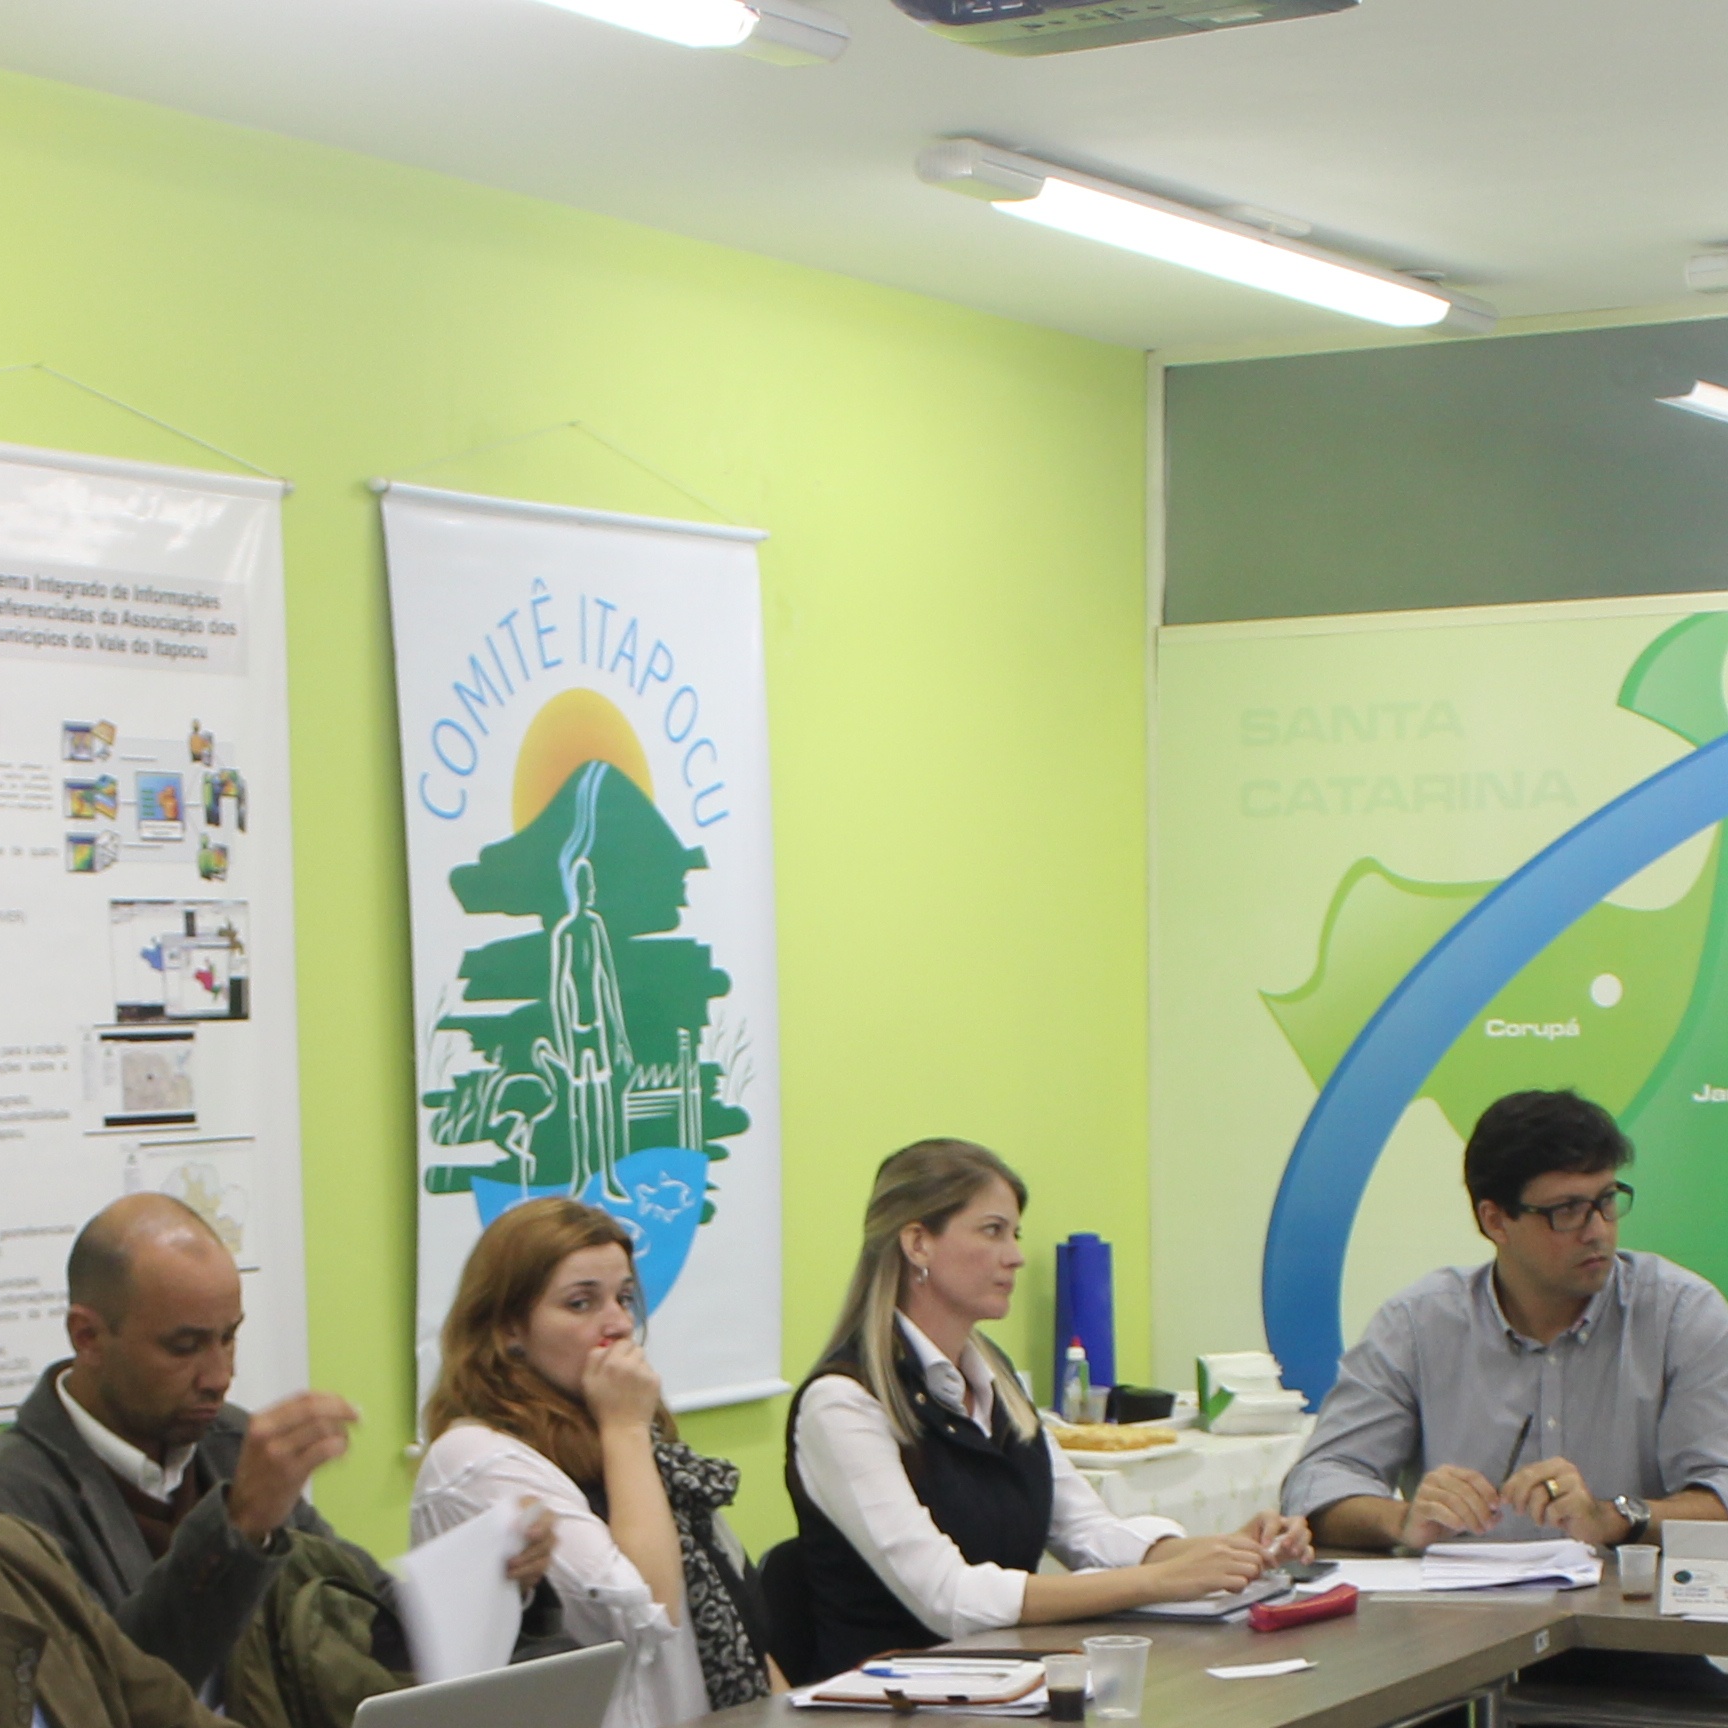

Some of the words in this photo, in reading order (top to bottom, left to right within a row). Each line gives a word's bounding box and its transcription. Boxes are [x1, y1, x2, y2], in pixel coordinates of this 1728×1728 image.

[34, 573, 107, 601] Integrado
[112, 582, 129, 602] de
[133, 585, 221, 611] Informações
[122, 608, 206, 637] Associação
[211, 618, 237, 637] dos
[75, 632, 93, 651] do
[97, 634, 128, 654] Vale
[132, 638, 151, 656] do
[154, 641, 208, 661] Itapocu
[418, 578, 565, 824] COMITÊ
[578, 593, 731, 828] ITAPOCU
[1238, 698, 1465, 748] SANTA
[1238, 769, 1581, 819] CATARINA
[1484, 1018, 1581, 1043] Corupá
